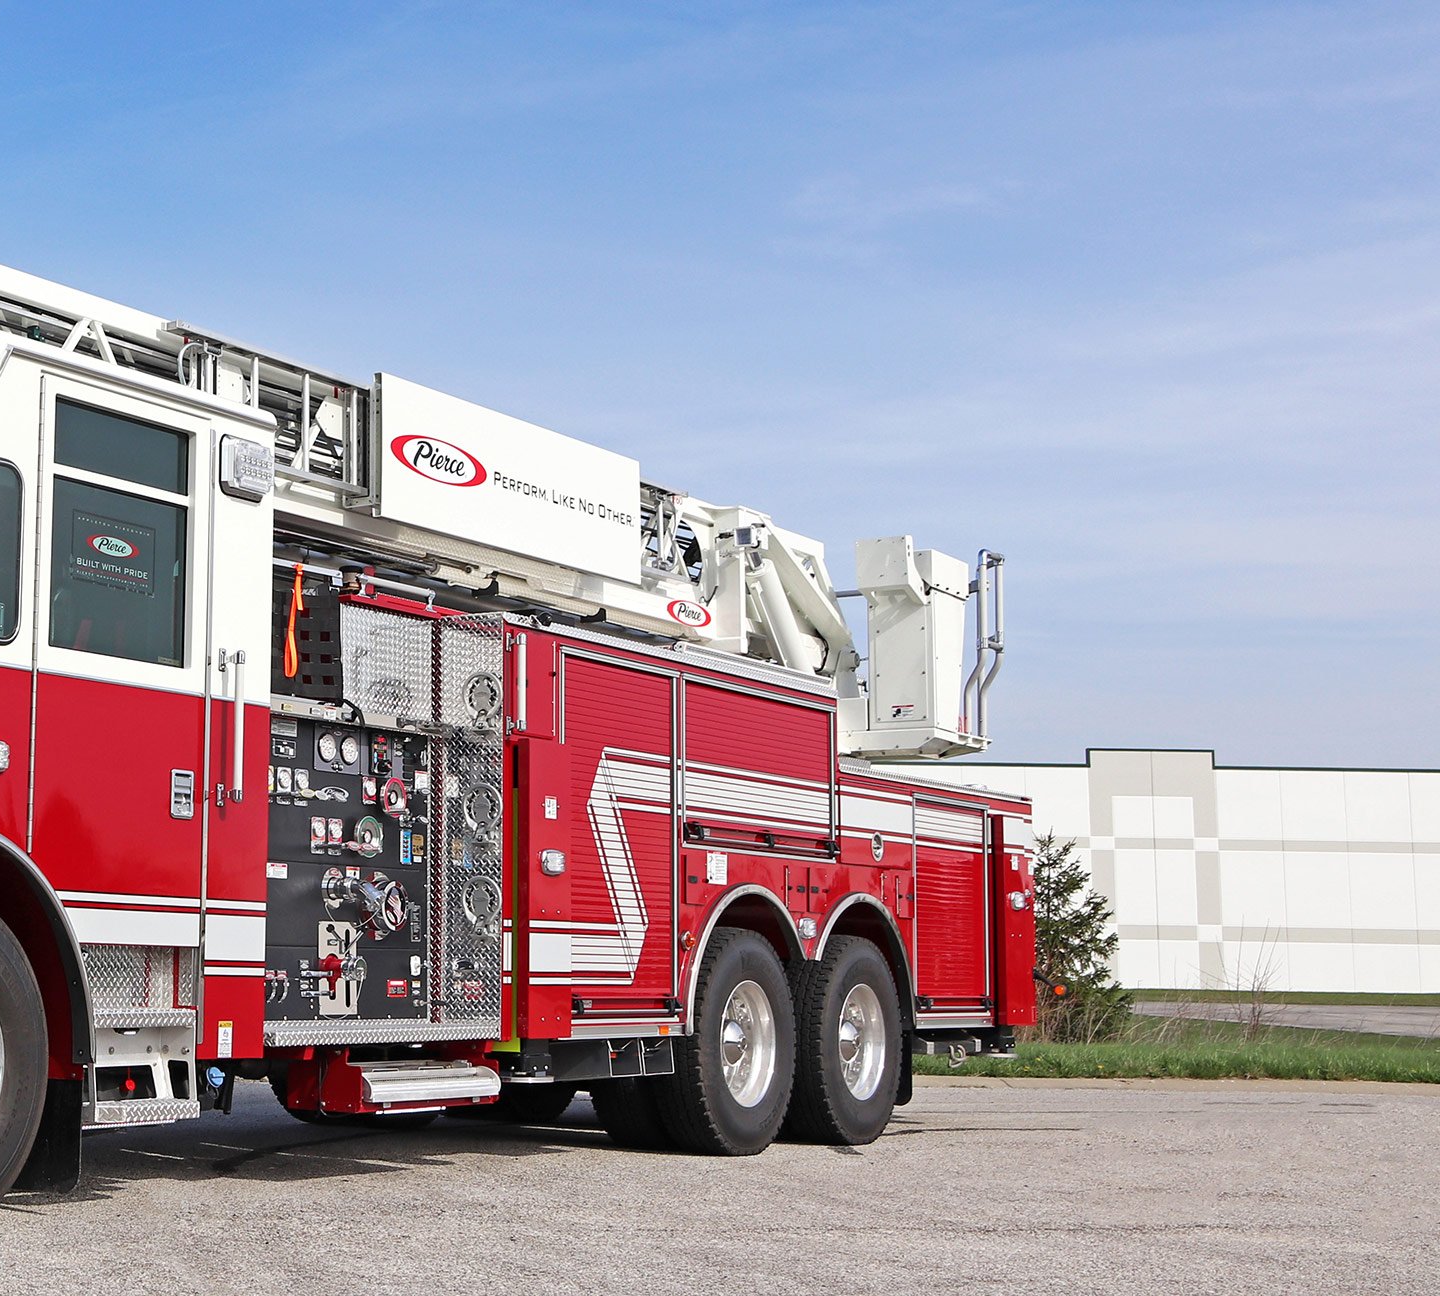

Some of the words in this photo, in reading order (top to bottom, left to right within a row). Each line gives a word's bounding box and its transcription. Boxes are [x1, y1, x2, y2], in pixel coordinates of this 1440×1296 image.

[413, 440, 465, 477] Pierce
[552, 489, 575, 510] LIKE
[578, 497, 595, 515] NO
[98, 537, 126, 554] Pierce
[76, 557, 100, 569] BUILT
[101, 562, 121, 574] WITH
[123, 567, 148, 580] PRIDE
[677, 602, 701, 621] Pierce
